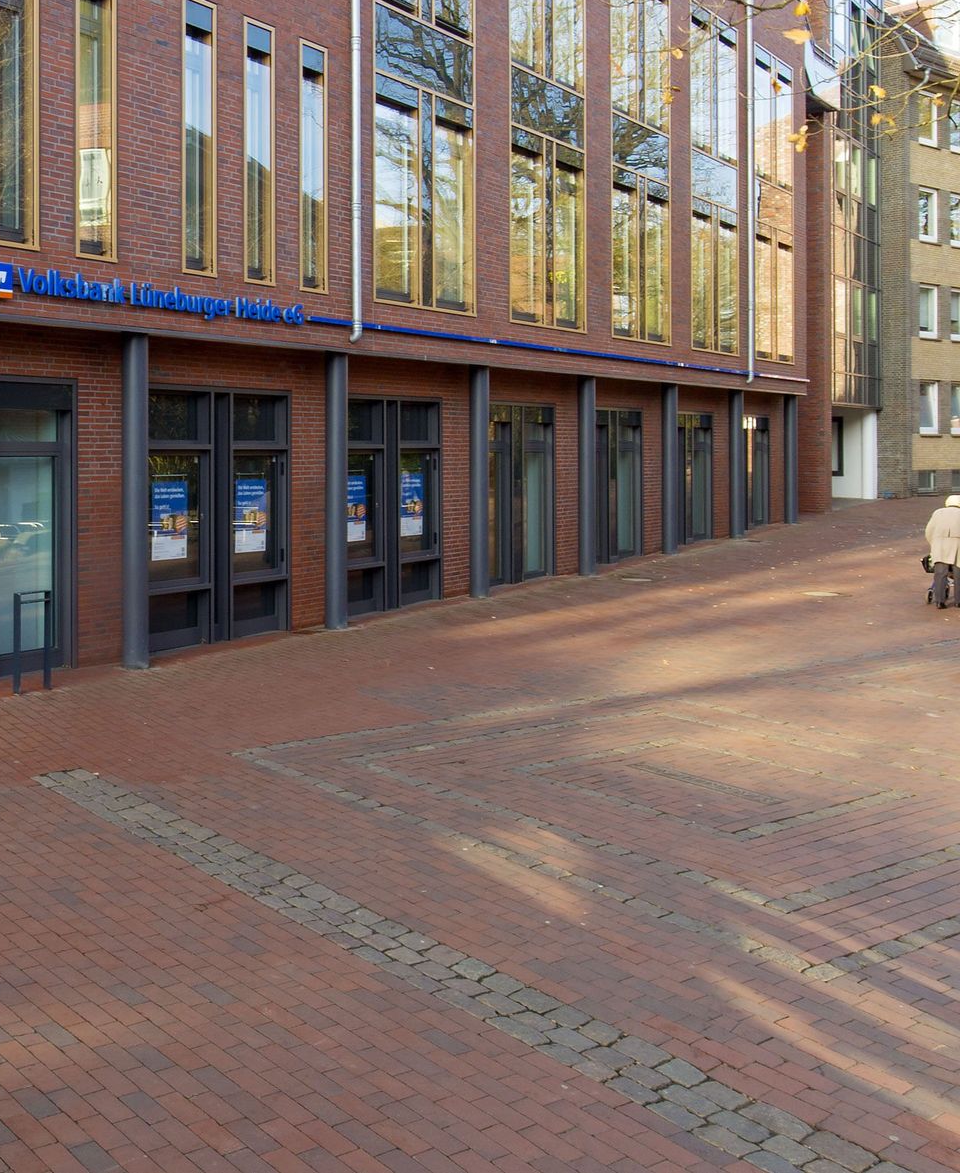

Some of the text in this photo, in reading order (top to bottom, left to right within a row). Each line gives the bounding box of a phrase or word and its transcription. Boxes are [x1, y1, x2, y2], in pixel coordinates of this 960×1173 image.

[18, 267, 305, 325] Volksbank Lüneburger Heide eG
